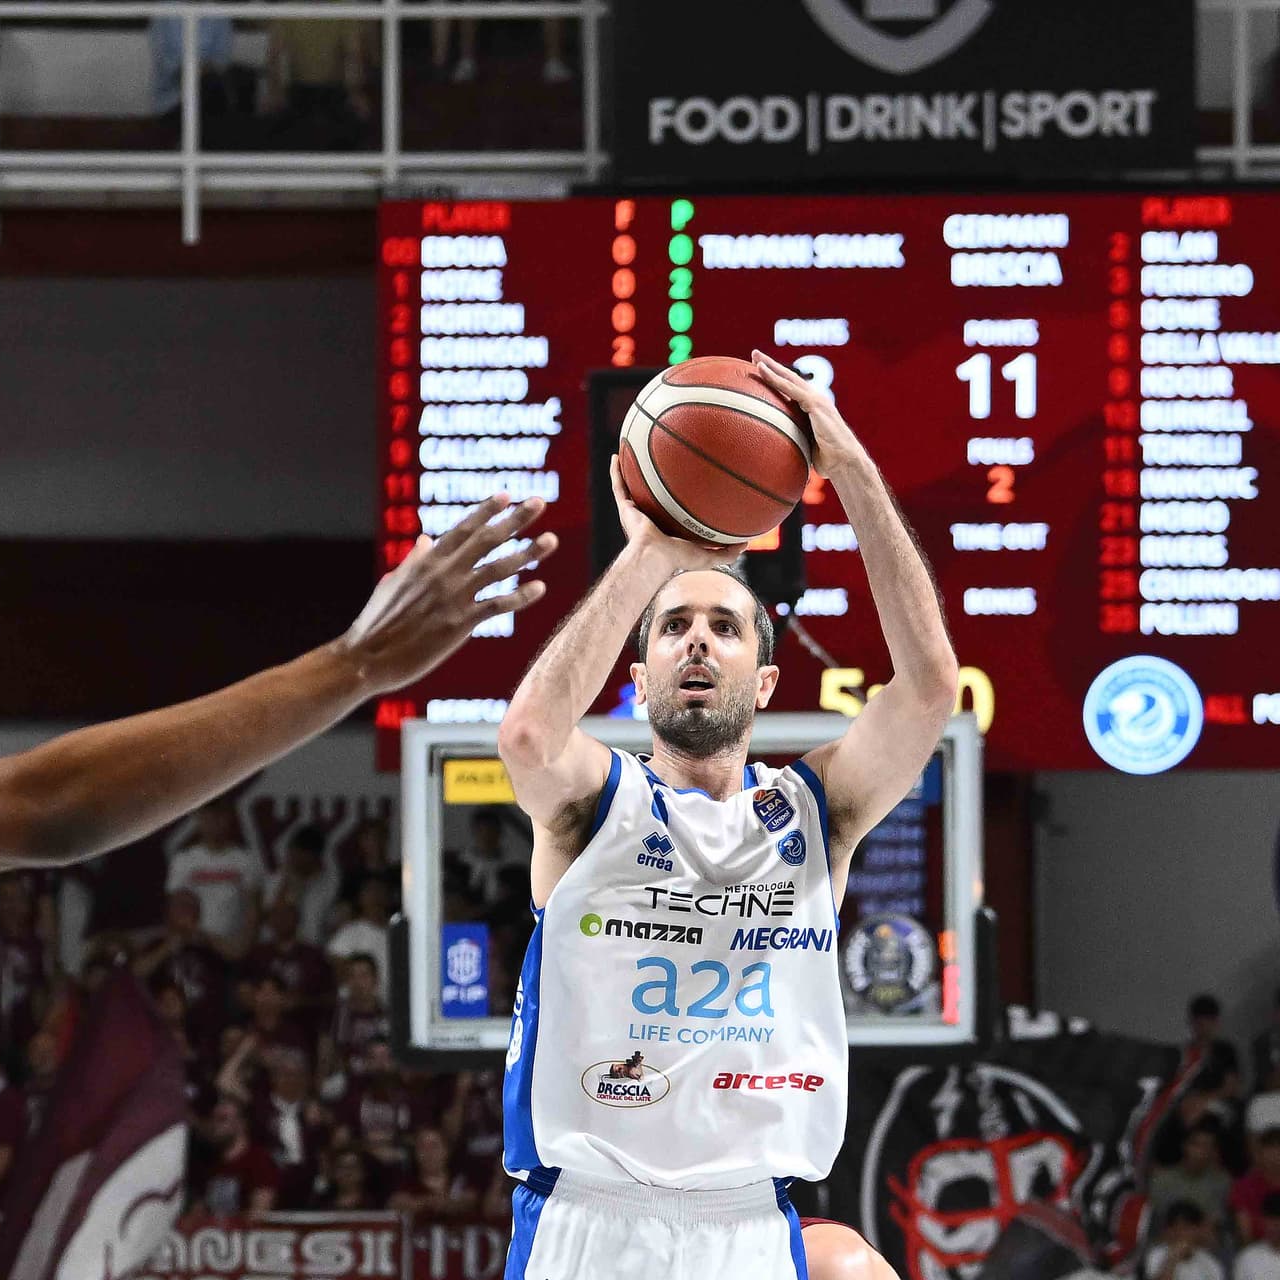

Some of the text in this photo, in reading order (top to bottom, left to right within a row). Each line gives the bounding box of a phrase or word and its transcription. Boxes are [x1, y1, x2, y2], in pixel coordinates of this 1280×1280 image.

[649, 90, 1157, 145] FOOD DRINK SPORT
[955, 352, 1037, 419] 11
[986, 464, 1016, 505] 2
[637, 852, 674, 872] errea
[724, 880, 795, 894] METROLOGIA
[644, 886, 795, 918] TECHNE
[605, 918, 704, 946] mazza
[730, 926, 832, 953] MEGRANI
[631, 956, 775, 1019] a2a
[628, 1023, 775, 1045] LIFE COMPANY
[597, 1081, 652, 1097] BRESCIA
[712, 1072, 825, 1093] arcese
